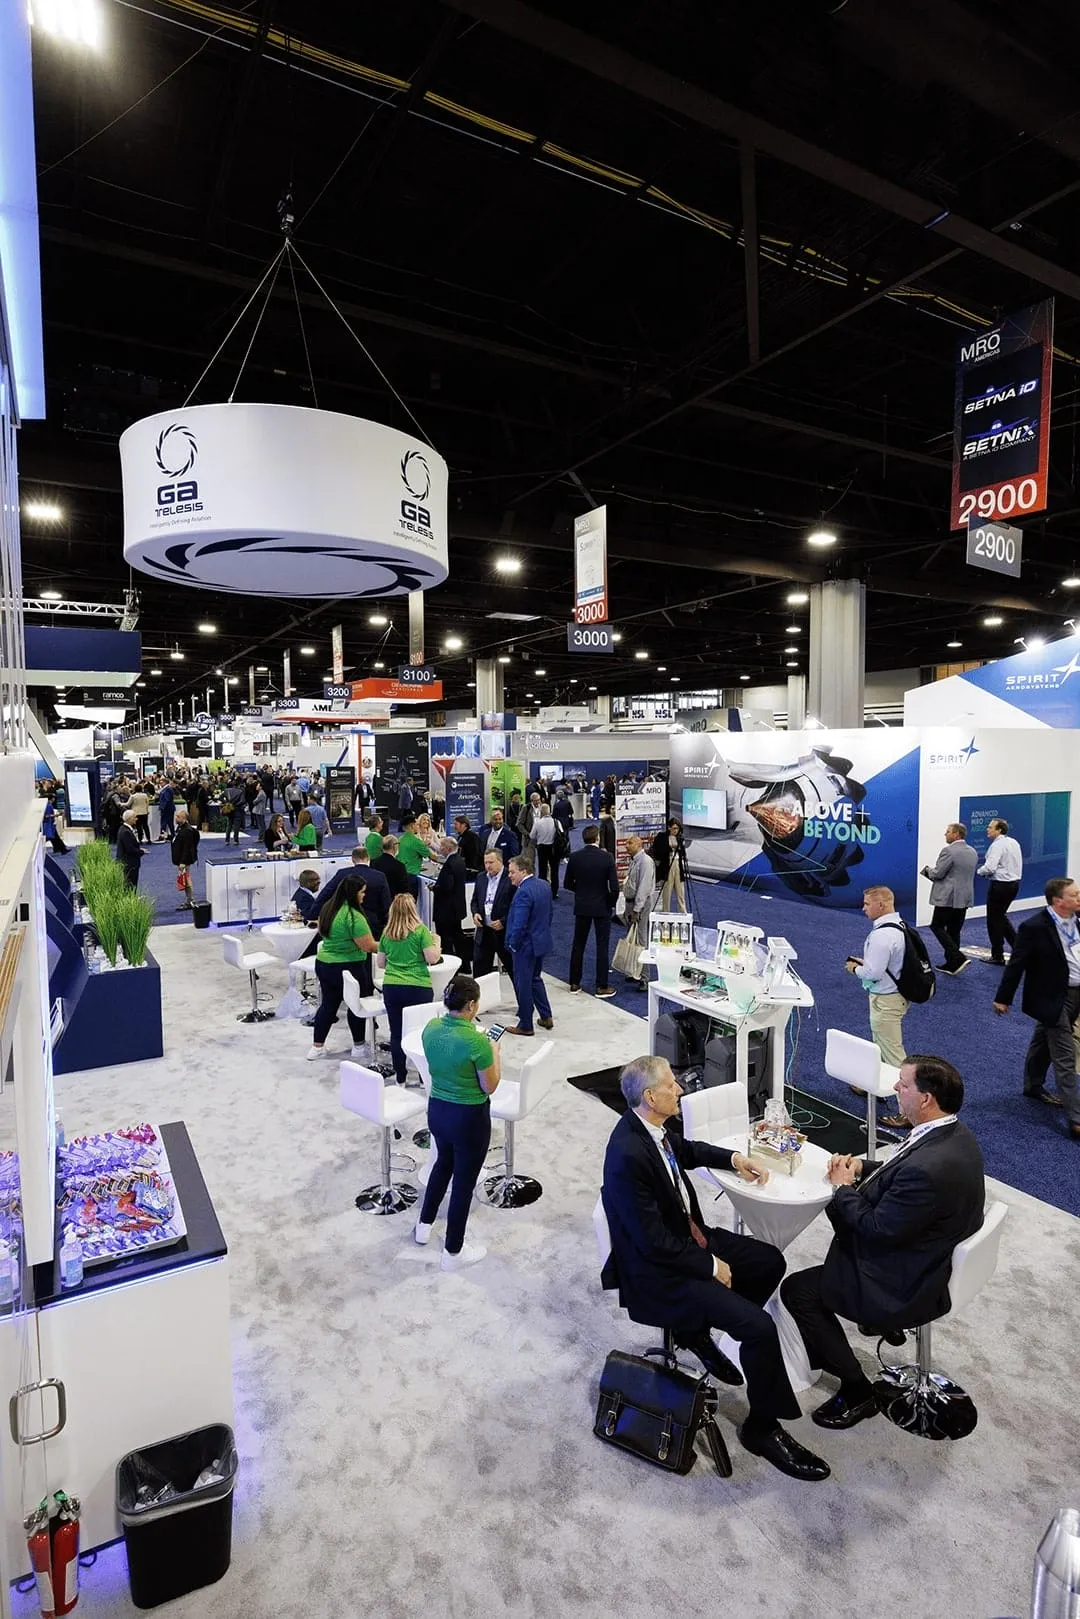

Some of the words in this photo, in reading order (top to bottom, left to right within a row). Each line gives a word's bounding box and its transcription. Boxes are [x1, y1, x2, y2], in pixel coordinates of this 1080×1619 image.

[961, 334, 1000, 362] MRO
[964, 388, 1016, 414] SETNA
[958, 478, 1037, 524] 2900
[974, 530, 1015, 564] 2900
[578, 602, 604, 623] 3000
[574, 631, 608, 646] 3000
[403, 670, 430, 680] 3100
[1006, 674, 1060, 684] SPIRIT
[328, 688, 349, 696] 3200
[690, 719, 706, 732] MRO
[930, 754, 963, 764] SPIRIT
[792, 800, 852, 821] ABOVE
[804, 820, 880, 844] BEYOND
